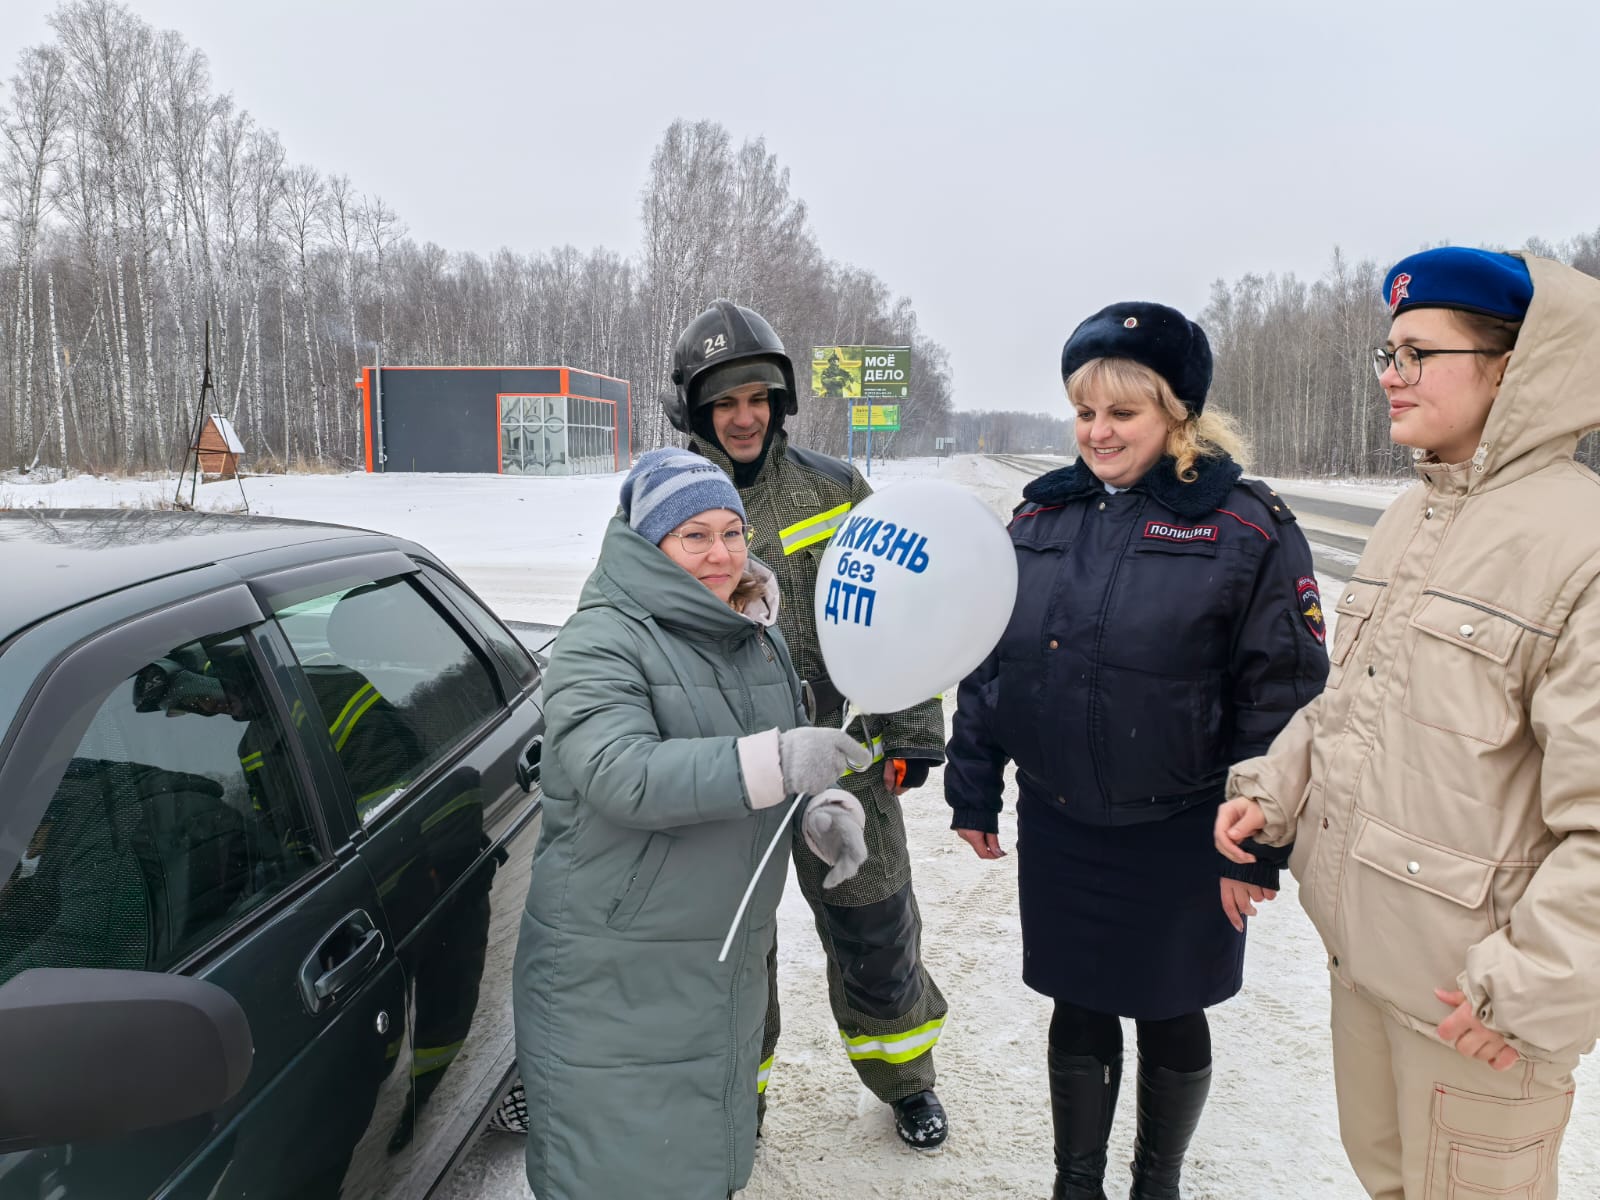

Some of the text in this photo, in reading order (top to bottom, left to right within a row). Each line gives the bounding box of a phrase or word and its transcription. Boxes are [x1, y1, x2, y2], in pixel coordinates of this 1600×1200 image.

[704, 333, 726, 354] 24
[864, 353, 896, 367] МОЁ
[864, 369, 904, 382] ДЕЛО
[1150, 525, 1212, 539] ПОЛИЦИЯ
[837, 516, 929, 574] ЖИЗНЬ
[837, 551, 875, 583] без
[825, 578, 877, 627] ДТП
